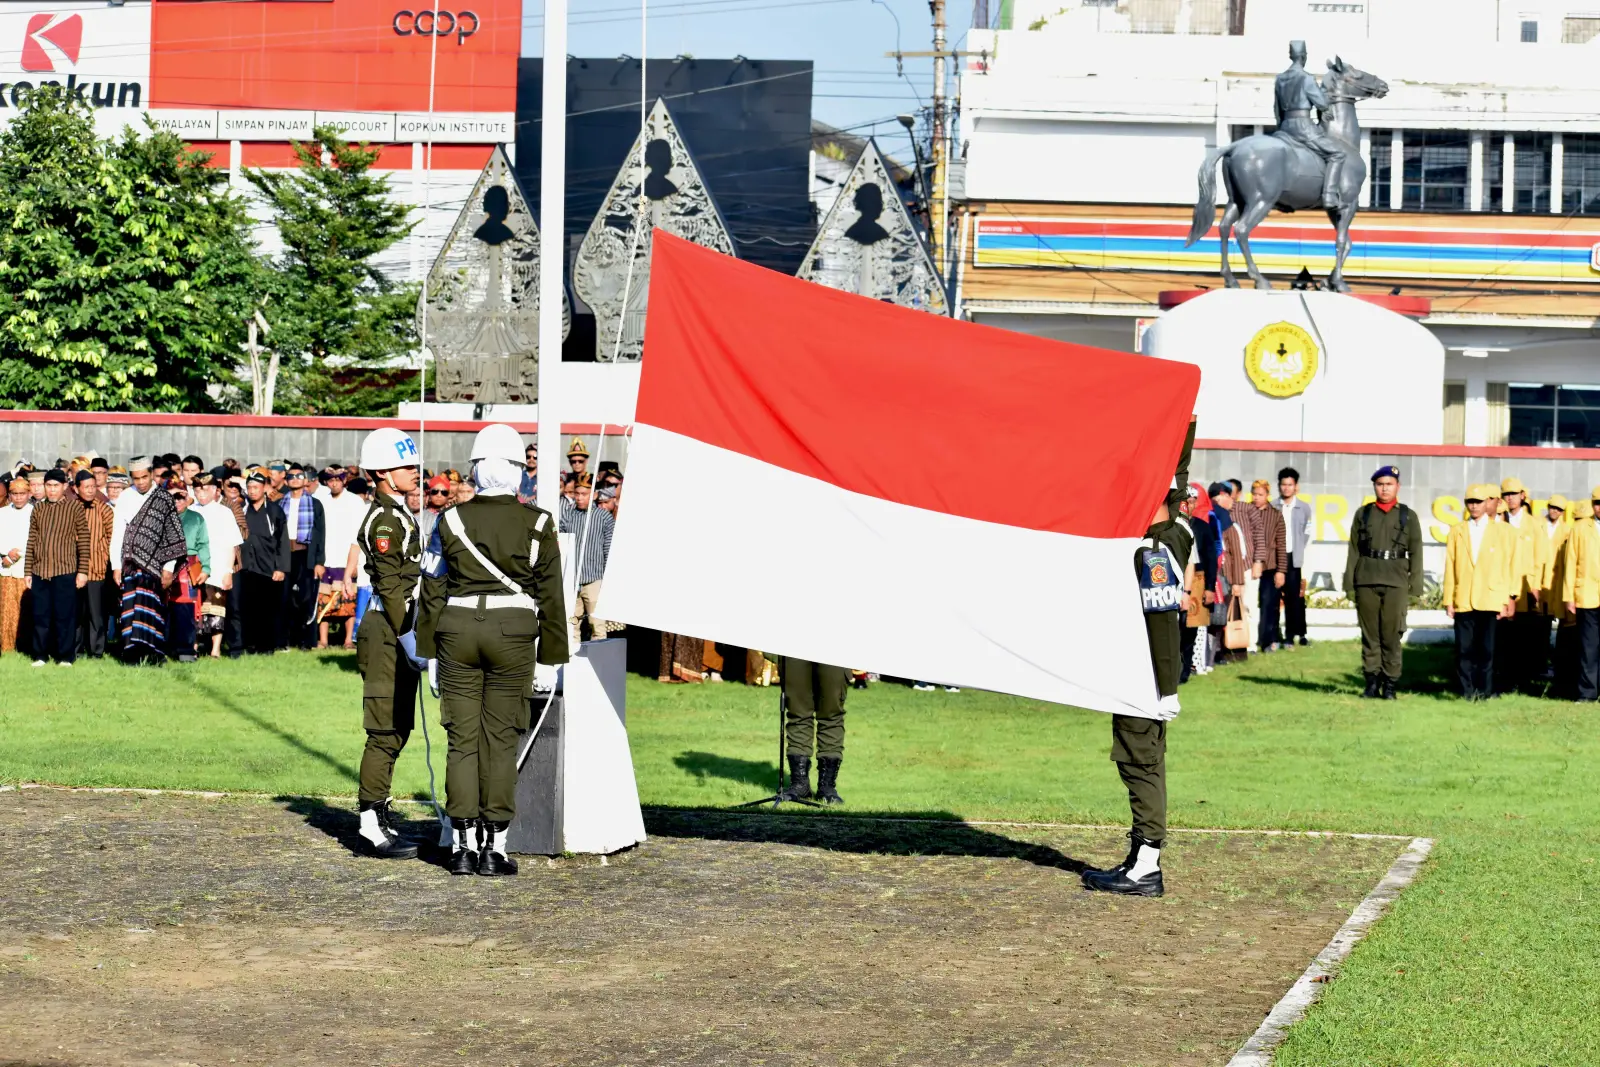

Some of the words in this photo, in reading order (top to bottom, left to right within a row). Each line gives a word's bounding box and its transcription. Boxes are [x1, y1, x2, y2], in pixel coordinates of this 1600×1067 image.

[393, 10, 479, 45] coop
[156, 119, 211, 129] SWALAYAN
[225, 119, 265, 130] SIMPAN
[268, 120, 308, 130] PINJAM
[322, 121, 388, 131] FOODCOURT
[400, 122, 446, 132] KOPKUN
[450, 123, 507, 133] INSTITUTE
